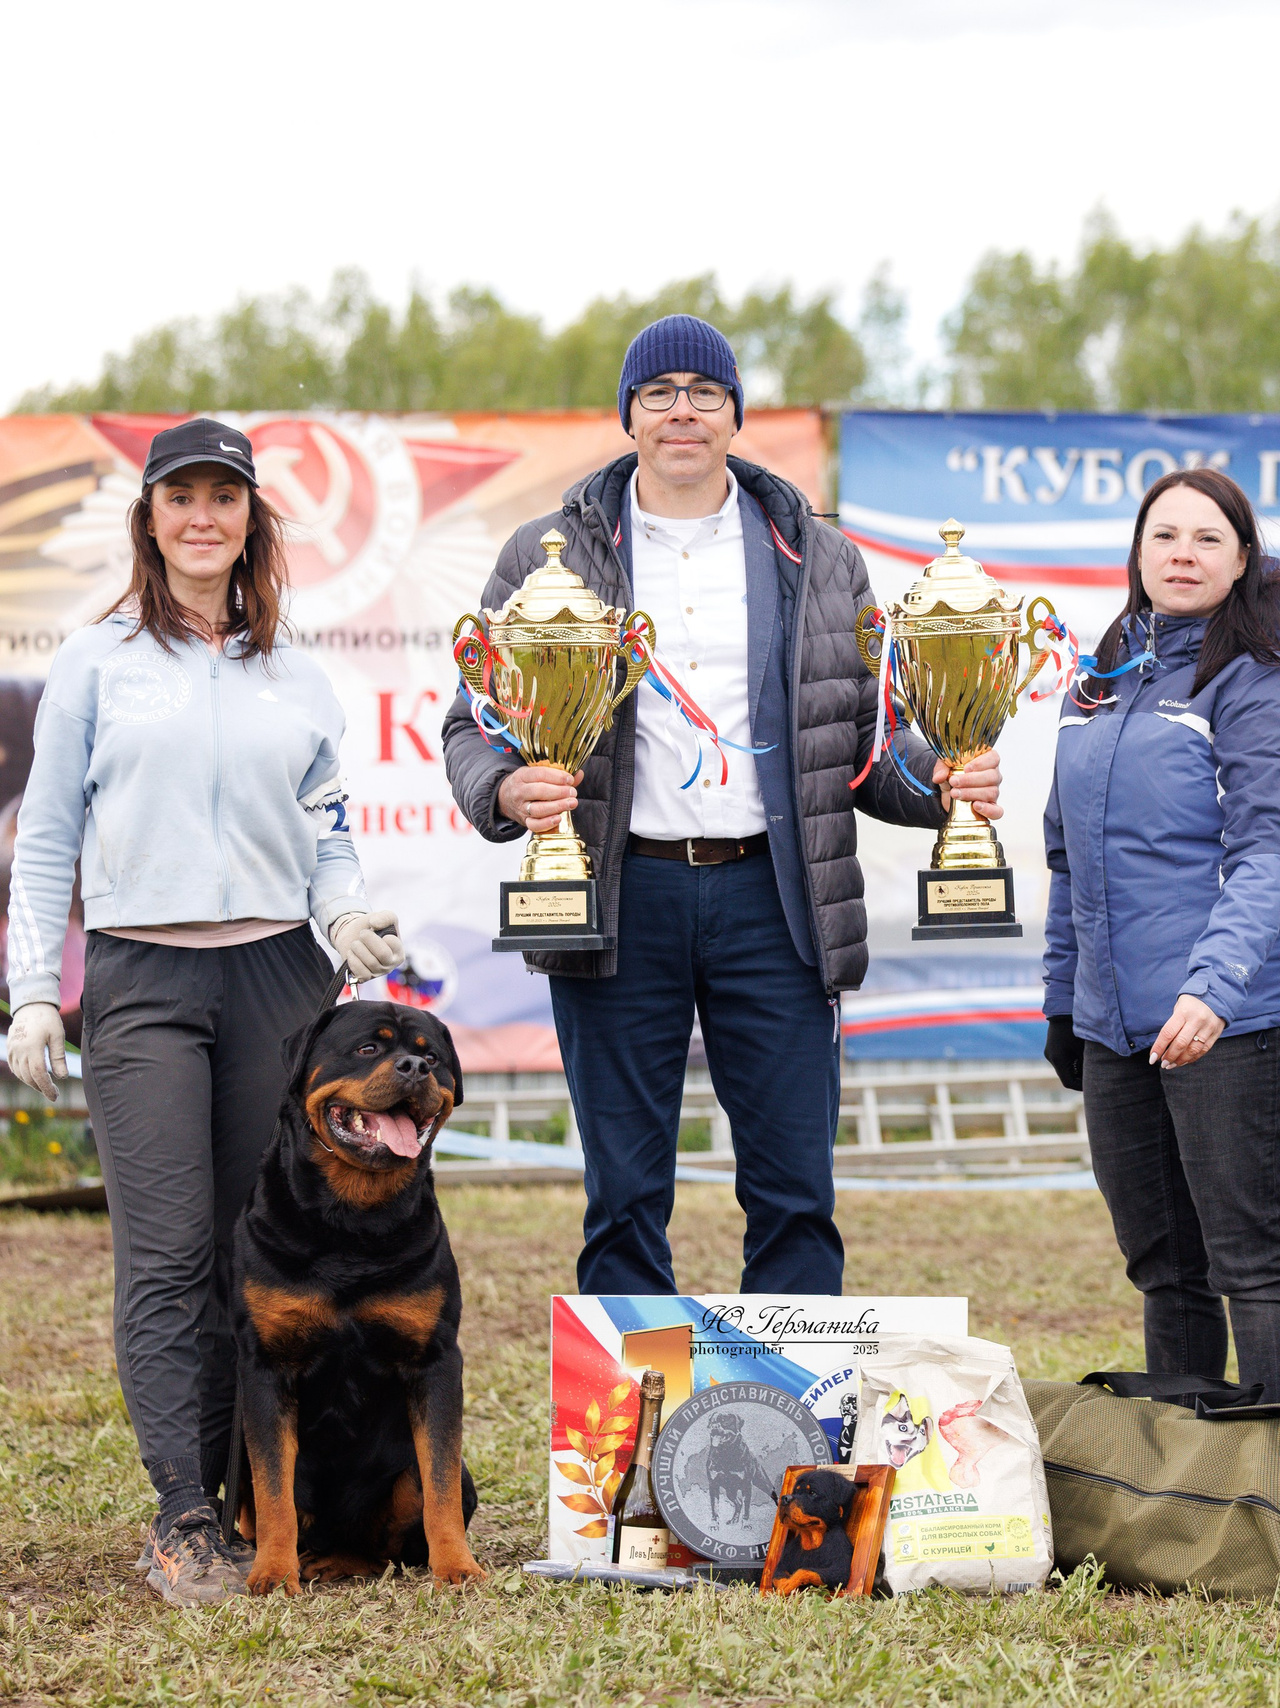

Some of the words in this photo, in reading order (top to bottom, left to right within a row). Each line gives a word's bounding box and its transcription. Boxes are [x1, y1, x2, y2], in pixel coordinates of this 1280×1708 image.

[152, 655, 184, 679] TORRA
[110, 706, 173, 722] ROTTWEILER
[324, 801, 350, 833] 2
[803, 1368, 854, 1411] ЕЙЛЕР
[657, 1427, 683, 1513] ЛУЧШИЙ
[682, 1386, 804, 1422] ПРЕДСТАВИТЕЛЬ
[903, 1492, 978, 1510] STATERA
[926, 1505, 966, 1514] BALANCE
[920, 1523, 985, 1533] СБАЛАНСИРОВАННЫЙ
[921, 1533, 937, 1541] ДЛЯ
[938, 1531, 978, 1540] ВЗРОСЛЫХ
[930, 1545, 972, 1555] КУРИЦЕЙ
